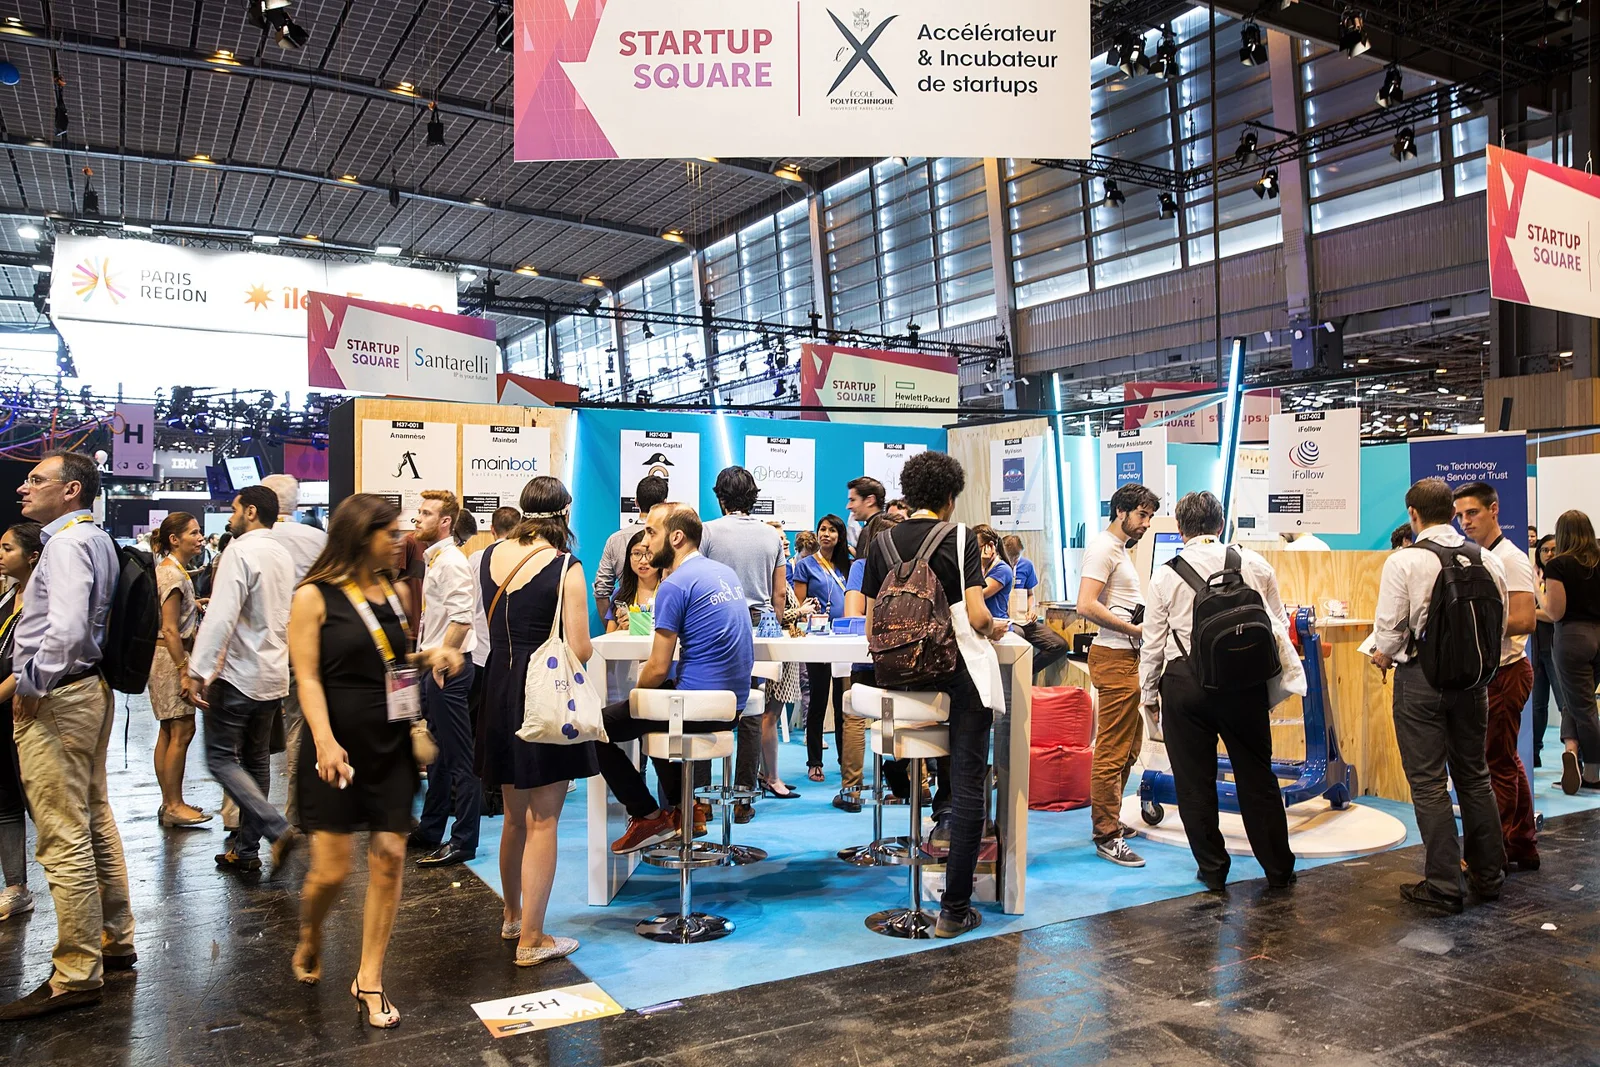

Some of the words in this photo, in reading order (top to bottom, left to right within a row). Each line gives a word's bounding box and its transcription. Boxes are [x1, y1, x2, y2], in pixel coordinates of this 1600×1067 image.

[917, 23, 1057, 43] Accélérateur
[619, 28, 773, 56] STARTUP
[917, 49, 932, 66] &
[939, 49, 1058, 69] Incubateur
[633, 62, 773, 89] SQUARE
[917, 75, 946, 92] de
[951, 77, 1039, 96] startups
[1527, 223, 1581, 251] STARTUP
[1533, 246, 1582, 272] SQUARE
[141, 269, 192, 286] PARIS
[141, 285, 207, 303] REGION
[346, 338, 400, 356] STARTUP
[352, 353, 400, 369] SQUARE
[414, 347, 489, 375] Santarelli
[832, 380, 876, 392] STARTUP
[836, 391, 876, 403] SQUARE
[895, 392, 922, 402] Hewlett
[923, 395, 950, 404] Packard
[1298, 412, 1321, 420] H37-002
[124, 423, 144, 445] H
[390, 432, 426, 440] Anamnèse
[1298, 425, 1321, 433] iFollow
[492, 436, 518, 444] Mainbot
[137, 462, 145, 470] G
[171, 458, 198, 469] IBM
[471, 456, 538, 472] mainbot
[1450, 461, 1497, 471] Technology
[769, 465, 804, 483] healsy
[1117, 471, 1141, 480] medway
[1291, 469, 1325, 480] iFollow
[1446, 472, 1477, 482] Service
[1478, 472, 1486, 480] of
[1487, 471, 1508, 480] Trust
[507, 998, 561, 1017] H37
